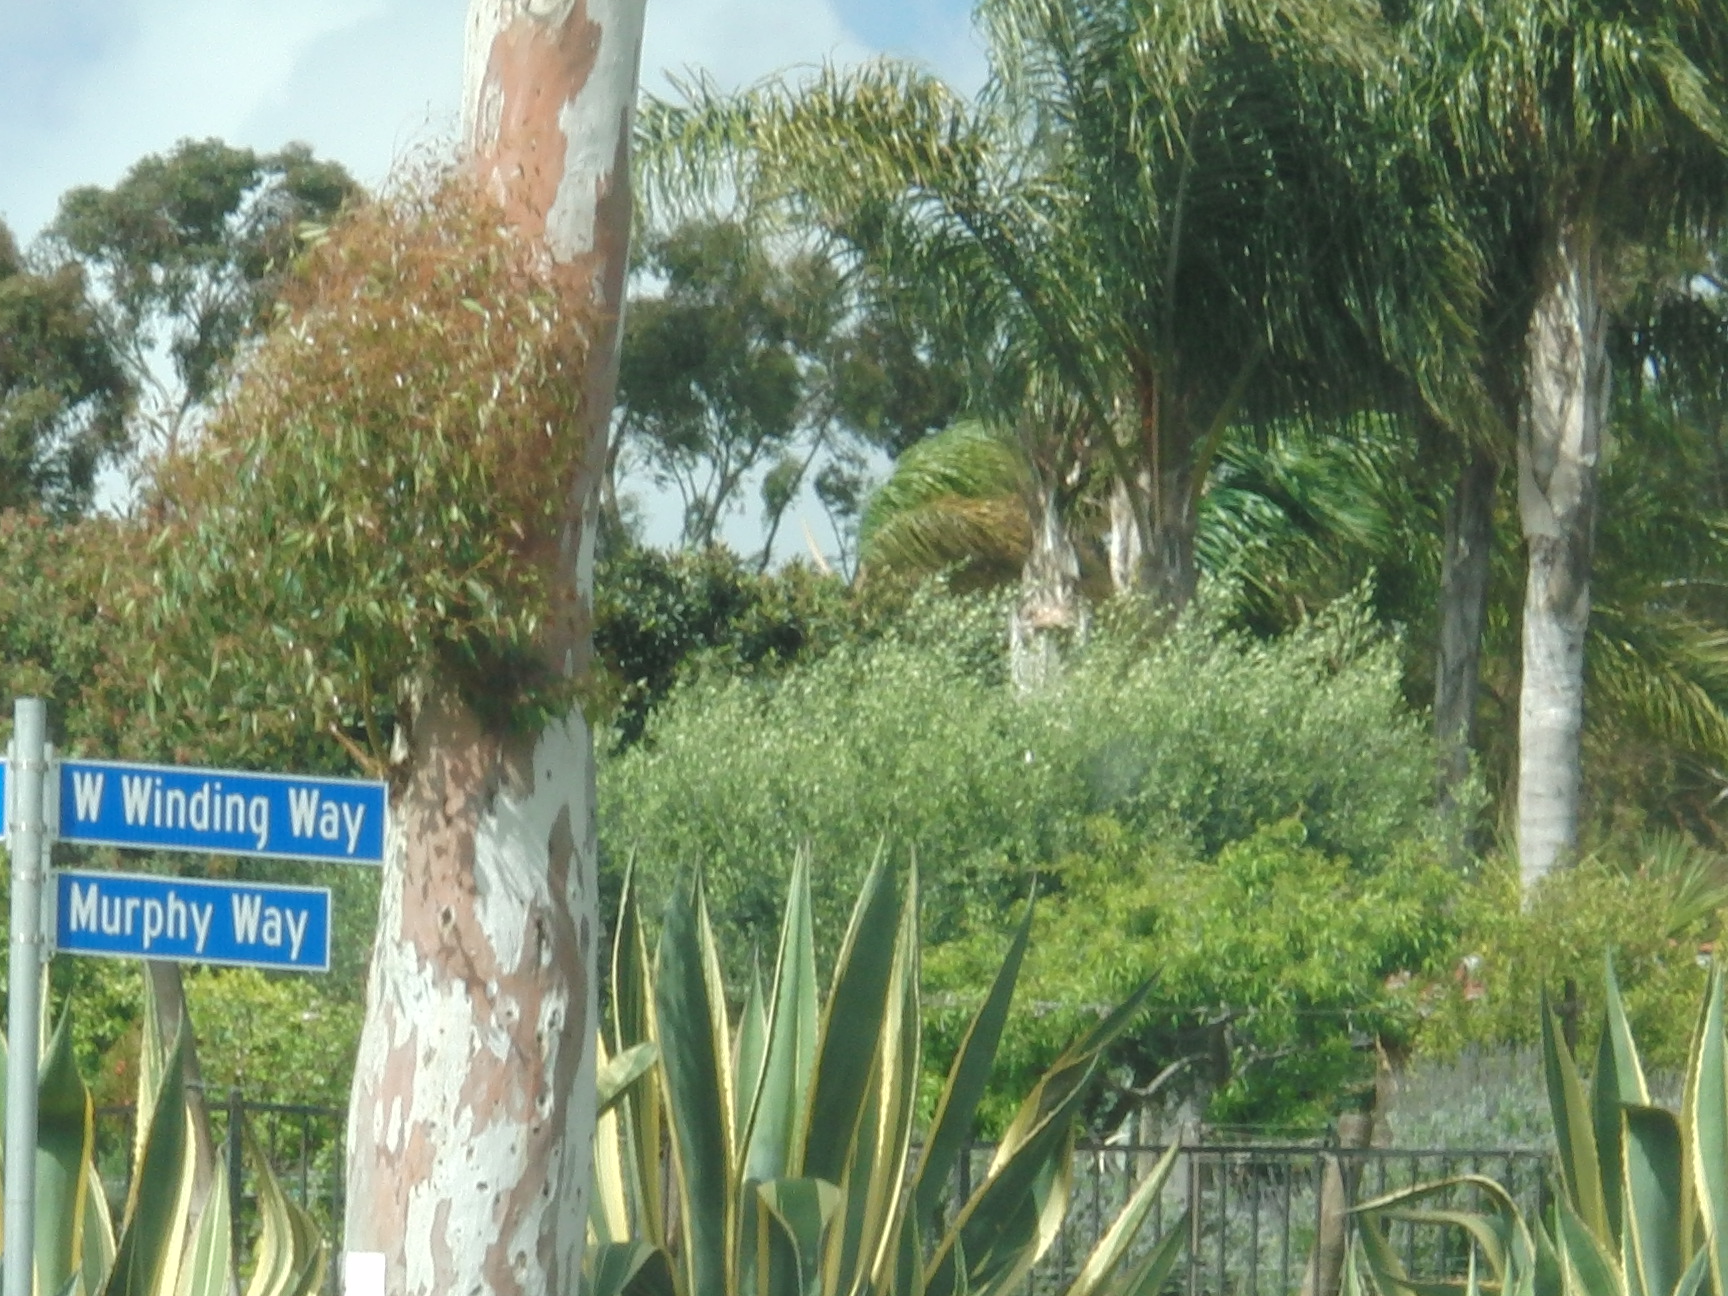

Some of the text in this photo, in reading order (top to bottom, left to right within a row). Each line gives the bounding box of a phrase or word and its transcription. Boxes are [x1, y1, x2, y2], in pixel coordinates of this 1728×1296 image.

[73, 771, 365, 854] W Winding Way
[69, 882, 309, 960] Murphy Way
